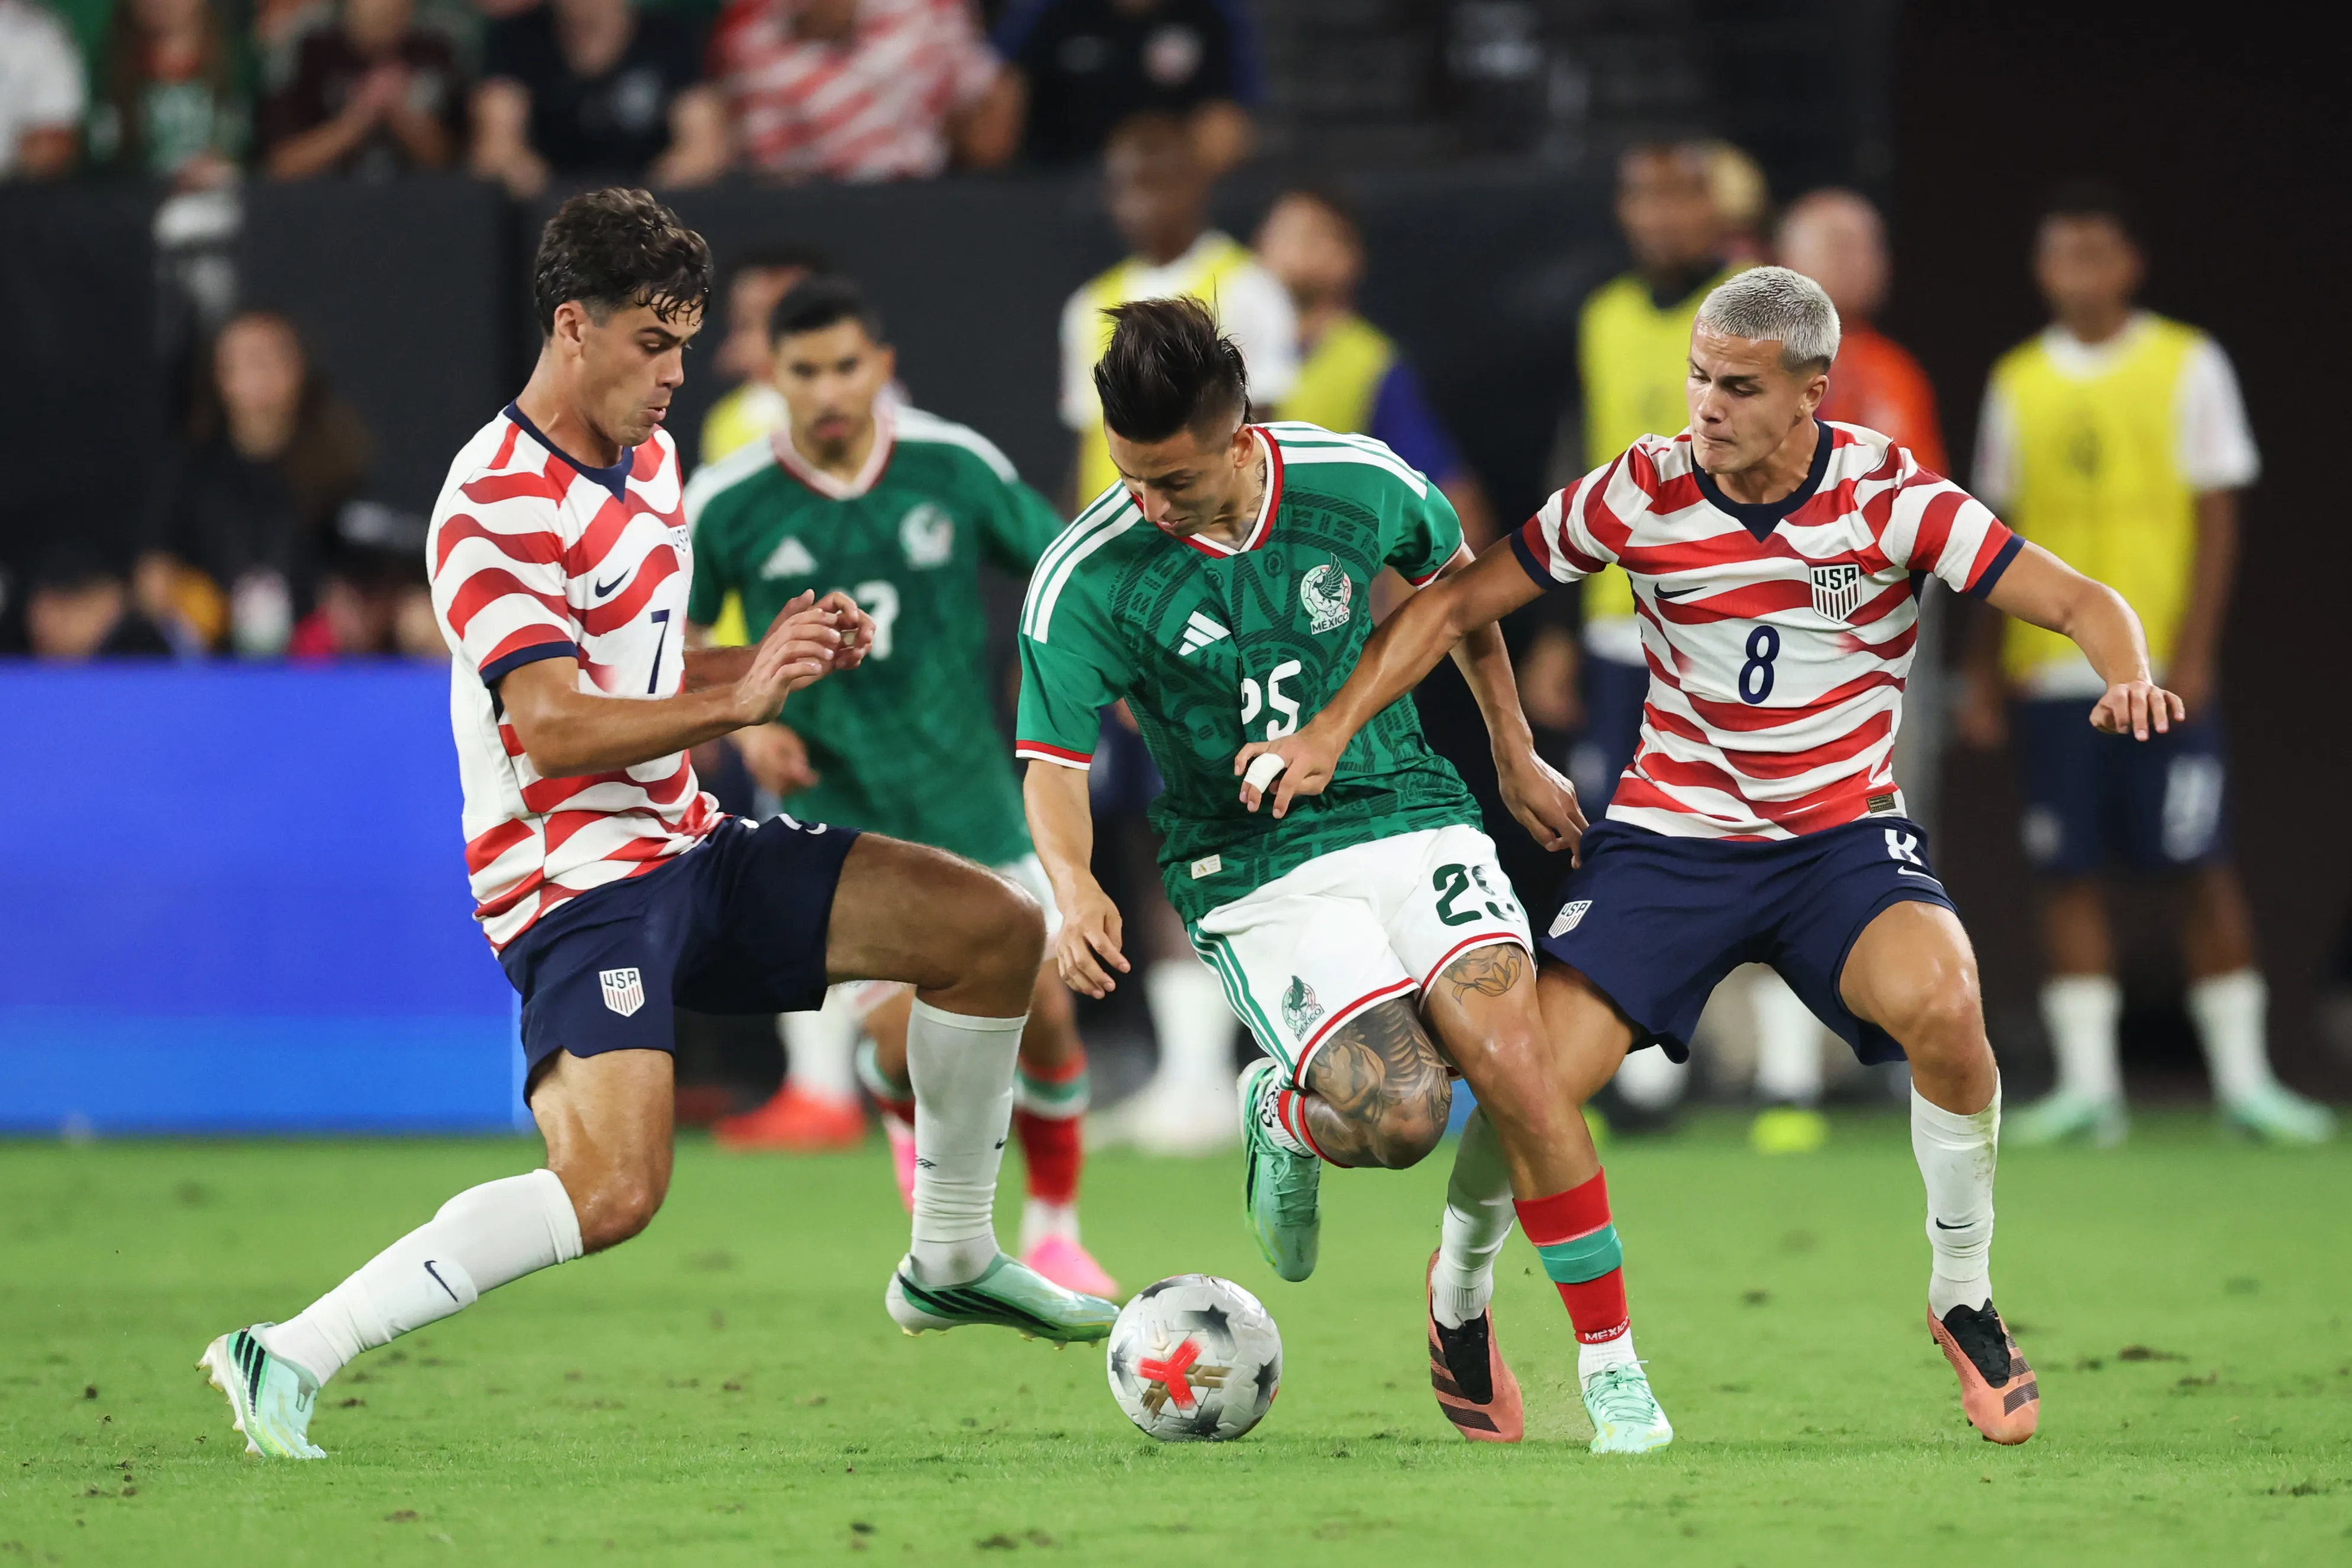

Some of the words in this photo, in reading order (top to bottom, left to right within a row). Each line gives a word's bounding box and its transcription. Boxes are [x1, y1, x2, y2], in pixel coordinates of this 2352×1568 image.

[1814, 567, 1856, 590] USA
[1311, 612, 1349, 632] MÉXICO
[647, 608, 671, 694] 7
[1738, 624, 1780, 705] 8
[1561, 902, 1589, 917] USA
[603, 970, 637, 989] USA
